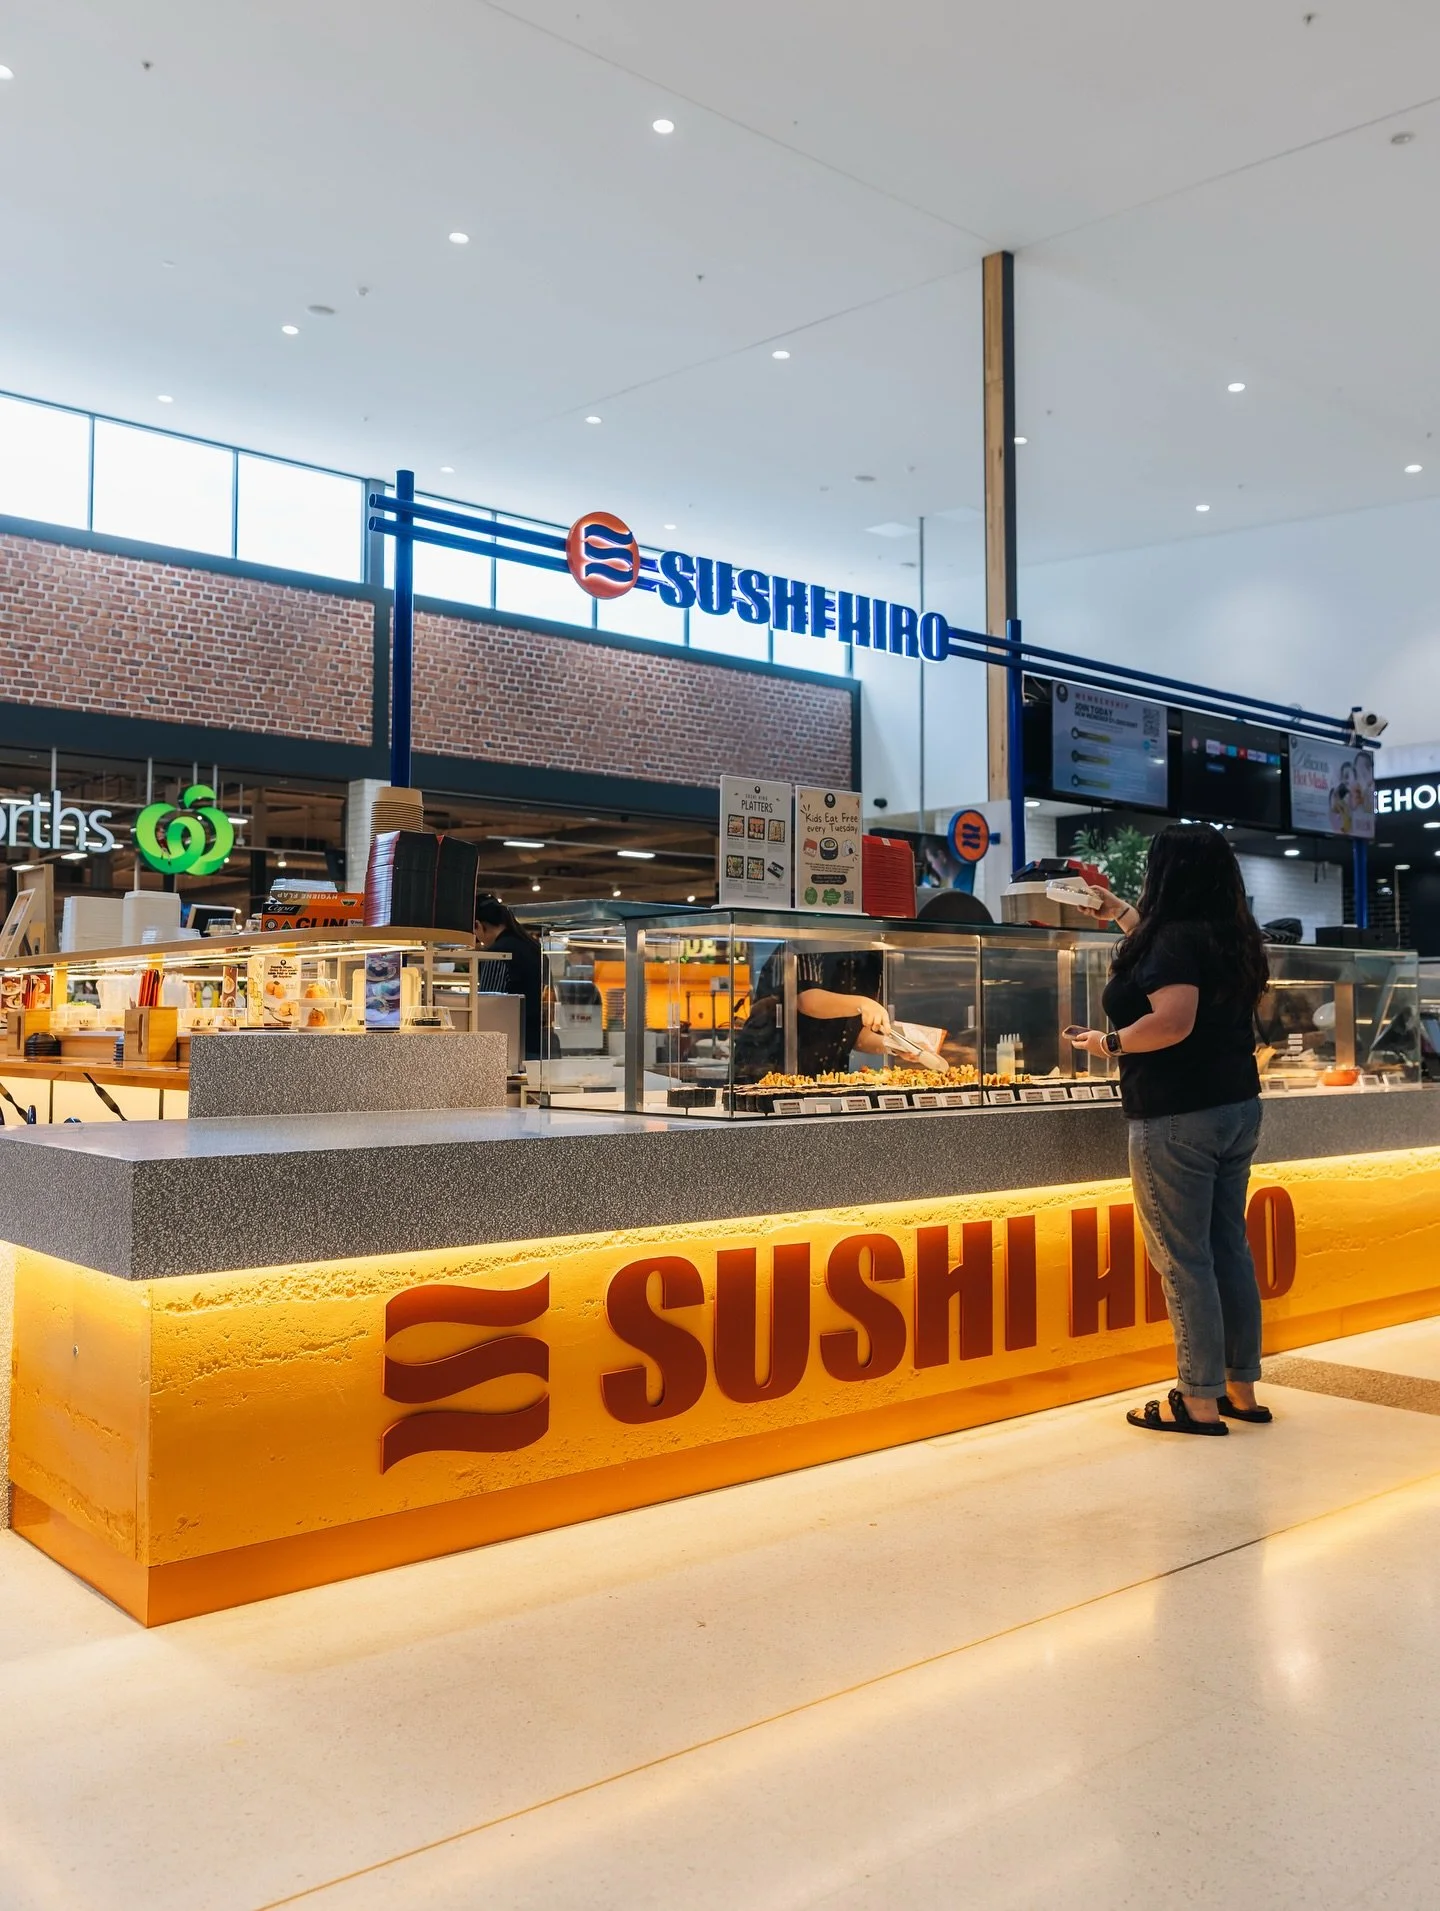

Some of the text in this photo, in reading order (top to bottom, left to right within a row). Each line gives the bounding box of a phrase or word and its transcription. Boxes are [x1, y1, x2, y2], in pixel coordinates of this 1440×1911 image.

[659, 551, 950, 663] SUSHI HIRO
[1090, 705, 1113, 717] TODAY
[741, 799, 773, 813] PLATTERS
[0, 790, 115, 853] rths
[805, 812, 858, 823] Kids Eat Free
[807, 822, 858, 836] every Tuesday
[601, 1186, 1297, 1424] SUSHI HO
